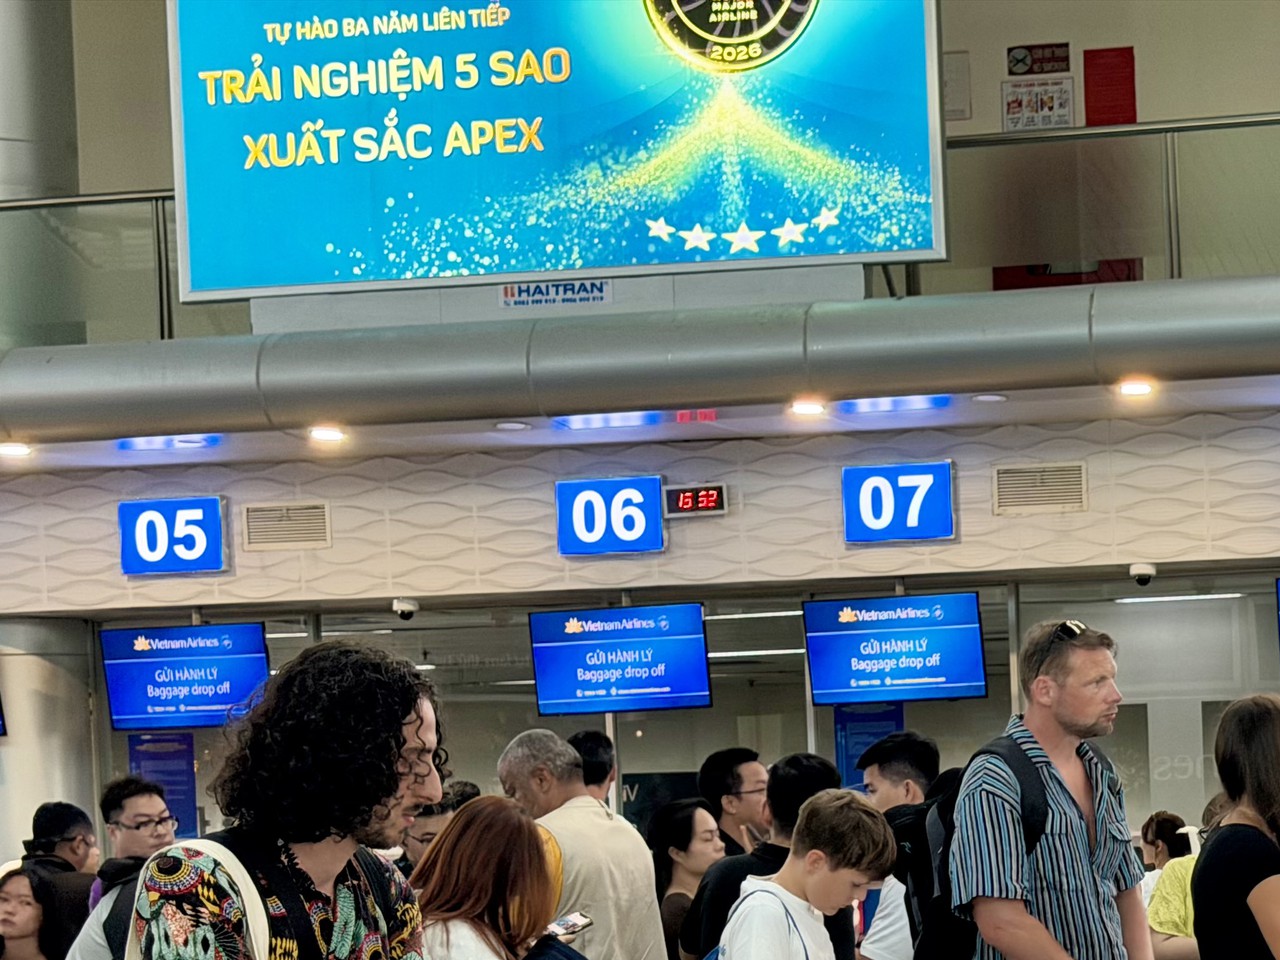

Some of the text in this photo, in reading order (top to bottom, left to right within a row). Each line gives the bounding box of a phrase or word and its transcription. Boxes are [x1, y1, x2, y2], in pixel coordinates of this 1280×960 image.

[264, 2, 510, 45] TỰ HÀO BA NĂM LIÊN TIẾP
[710, 43, 762, 62] 2026
[199, 47, 572, 106] TRẢI NGHIỆM 5 SAO
[243, 107, 545, 170] XUẤT SẮC APEX
[859, 474, 934, 530] 07
[572, 488, 646, 543] 06
[135, 509, 207, 562] 05
[881, 638, 913, 653] HÀNH
[916, 637, 928, 652] LÝ
[608, 649, 638, 664] HÀNH
[641, 647, 653, 662] LÝ
[851, 653, 941, 673] Baggage drop off
[176, 667, 205, 681] HÀNH
[207, 666, 218, 680] LÝ
[577, 663, 666, 683] Baggage drop off
[147, 681, 230, 700] Baggage drop off
